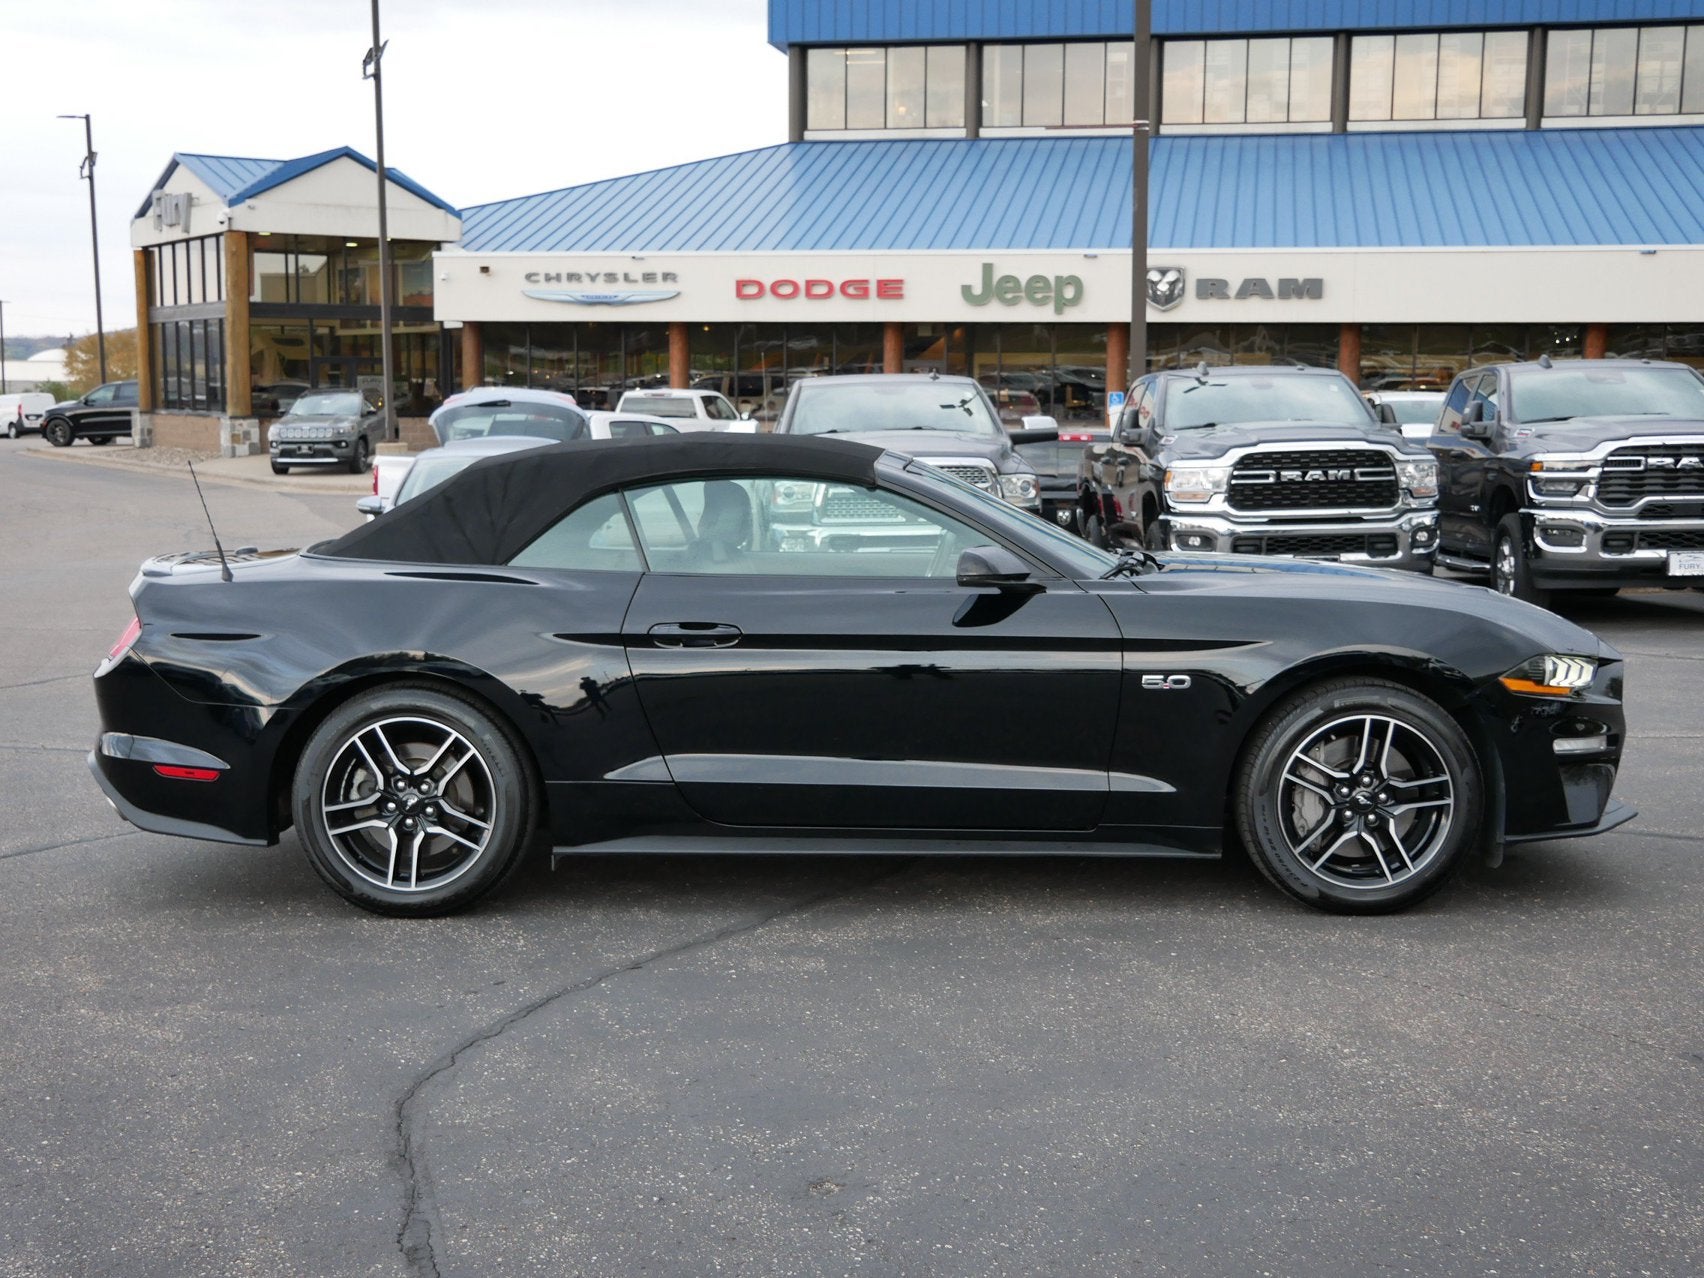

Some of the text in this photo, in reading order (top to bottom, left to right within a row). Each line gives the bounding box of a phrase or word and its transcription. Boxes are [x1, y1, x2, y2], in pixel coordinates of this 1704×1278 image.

[525, 272, 679, 284] CHRYSLER
[735, 279, 905, 300] DODGE
[961, 262, 1085, 315] Jeep
[1196, 278, 1323, 300] RAM
[1280, 470, 1351, 481] RAM
[1142, 674, 1191, 689] 5.0
